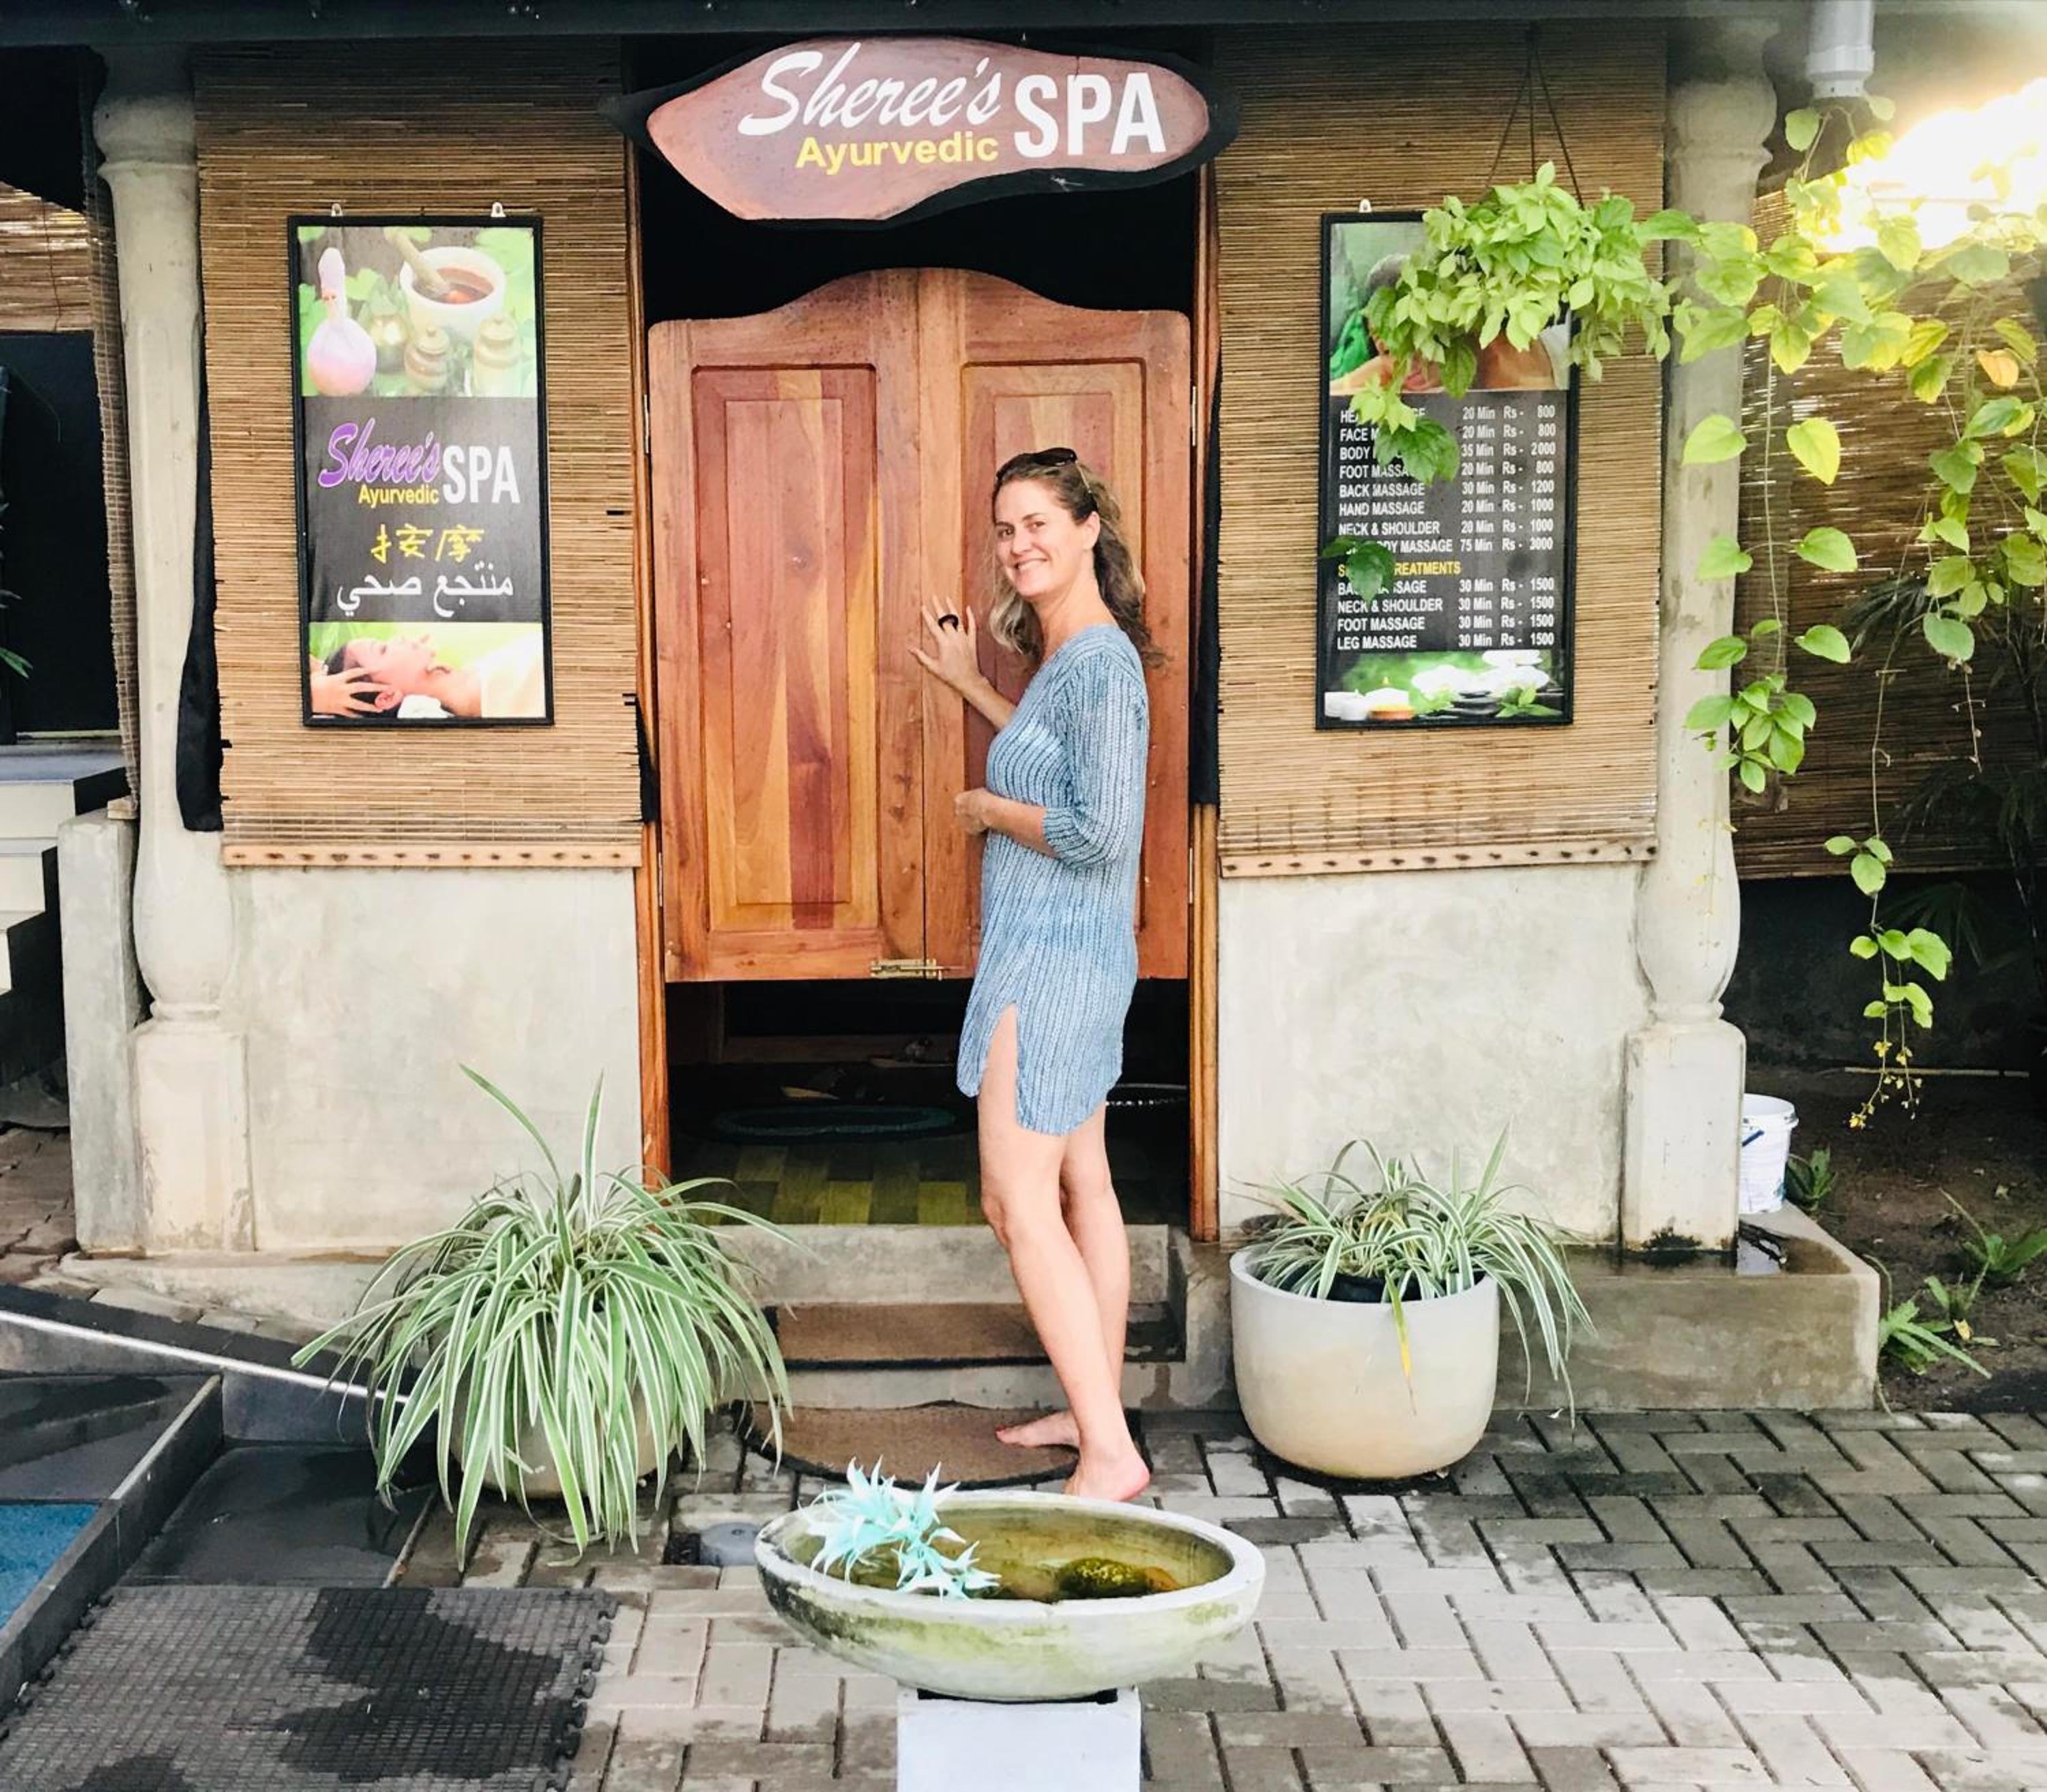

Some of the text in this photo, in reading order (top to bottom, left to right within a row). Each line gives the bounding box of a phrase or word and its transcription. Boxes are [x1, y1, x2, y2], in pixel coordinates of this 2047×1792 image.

[738, 42, 1167, 158] Sheree's SPA
[795, 132, 1000, 176] Ayurvedic
[1462, 406, 1475, 420] 20
[1477, 406, 1496, 420] Min
[1503, 405, 1518, 419] Rs
[1339, 428, 1368, 442] FACE
[1462, 425, 1475, 439] 20
[1477, 424, 1495, 438] Min
[1503, 424, 1517, 437] Rs
[1538, 423, 1556, 437] 800
[1339, 446, 1370, 461] BODY
[1462, 444, 1474, 457] 35
[1476, 443, 1494, 457] Min
[1503, 442, 1517, 456] Rs
[1530, 442, 1556, 456] 2000
[317, 416, 521, 504] Sheree's SPA
[1339, 463, 1409, 479] FOOT MASSA
[1462, 462, 1474, 476] 20
[1476, 461, 1494, 476] Min
[1502, 461, 1516, 475] Rs
[1339, 482, 1425, 498] BACK MASSAGE
[1462, 480, 1475, 495] 30
[1476, 480, 1494, 495] Min
[1502, 480, 1516, 494] Rs
[1531, 479, 1554, 493] 1200
[358, 485, 440, 509] Ayurvedic
[1339, 501, 1425, 517] HAND MASSAGE
[1461, 500, 1474, 514] 20
[1476, 499, 1494, 513] Min
[1502, 499, 1516, 512] Rs
[1530, 498, 1554, 512] 1000
[1338, 521, 1440, 536] NECK & SHOULDER
[1461, 519, 1474, 534] 20
[1476, 519, 1494, 533] Min
[1502, 519, 1516, 532] Rs
[1530, 518, 1554, 532] 1000
[1400, 538, 1453, 553] MASSAGE
[1460, 538, 1472, 552] 75
[1475, 538, 1493, 551] Min
[1502, 537, 1515, 551] Rs
[1394, 561, 1462, 575] REATMENTS
[336, 561, 514, 618] منتجع صحي
[1459, 579, 1472, 592] 30
[1474, 578, 1493, 592] Min
[1502, 578, 1515, 592] Rs
[1530, 577, 1554, 591] 1500
[1337, 598, 1443, 613] NECK & SHOULDER
[1458, 597, 1470, 611] 30
[1473, 596, 1492, 610] Min
[1501, 596, 1515, 609] Rs
[1530, 596, 1554, 609] 1500
[1337, 617, 1425, 631] FOOT MASSAGE
[1458, 615, 1470, 628] 30
[1473, 615, 1492, 628] Min
[1501, 615, 1515, 628] Rs
[1530, 613, 1554, 627] 1500
[1337, 635, 1417, 650] LEG MASSAGE
[1458, 633, 1470, 647] 30
[1473, 633, 1492, 647] Min
[1501, 633, 1515, 646] Rs
[1530, 632, 1554, 646] 1500
